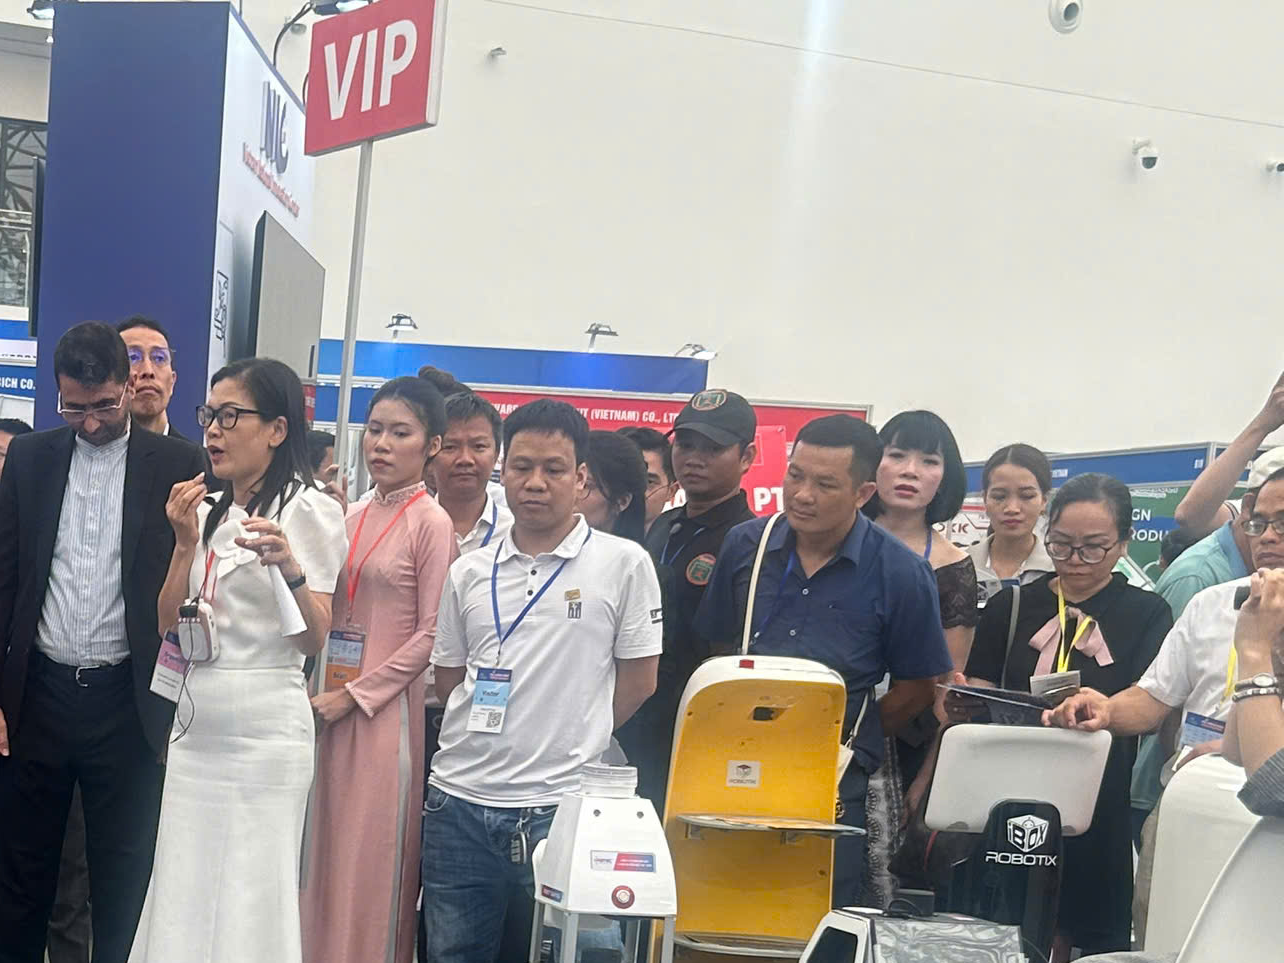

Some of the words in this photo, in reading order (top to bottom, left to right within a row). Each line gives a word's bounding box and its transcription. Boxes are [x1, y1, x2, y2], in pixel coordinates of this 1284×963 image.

[324, 20, 418, 121] VIP
[20, 378, 36, 391] CO.
[590, 408, 639, 422] (VIETNAM)
[985, 851, 1057, 866] ROBOTIX
